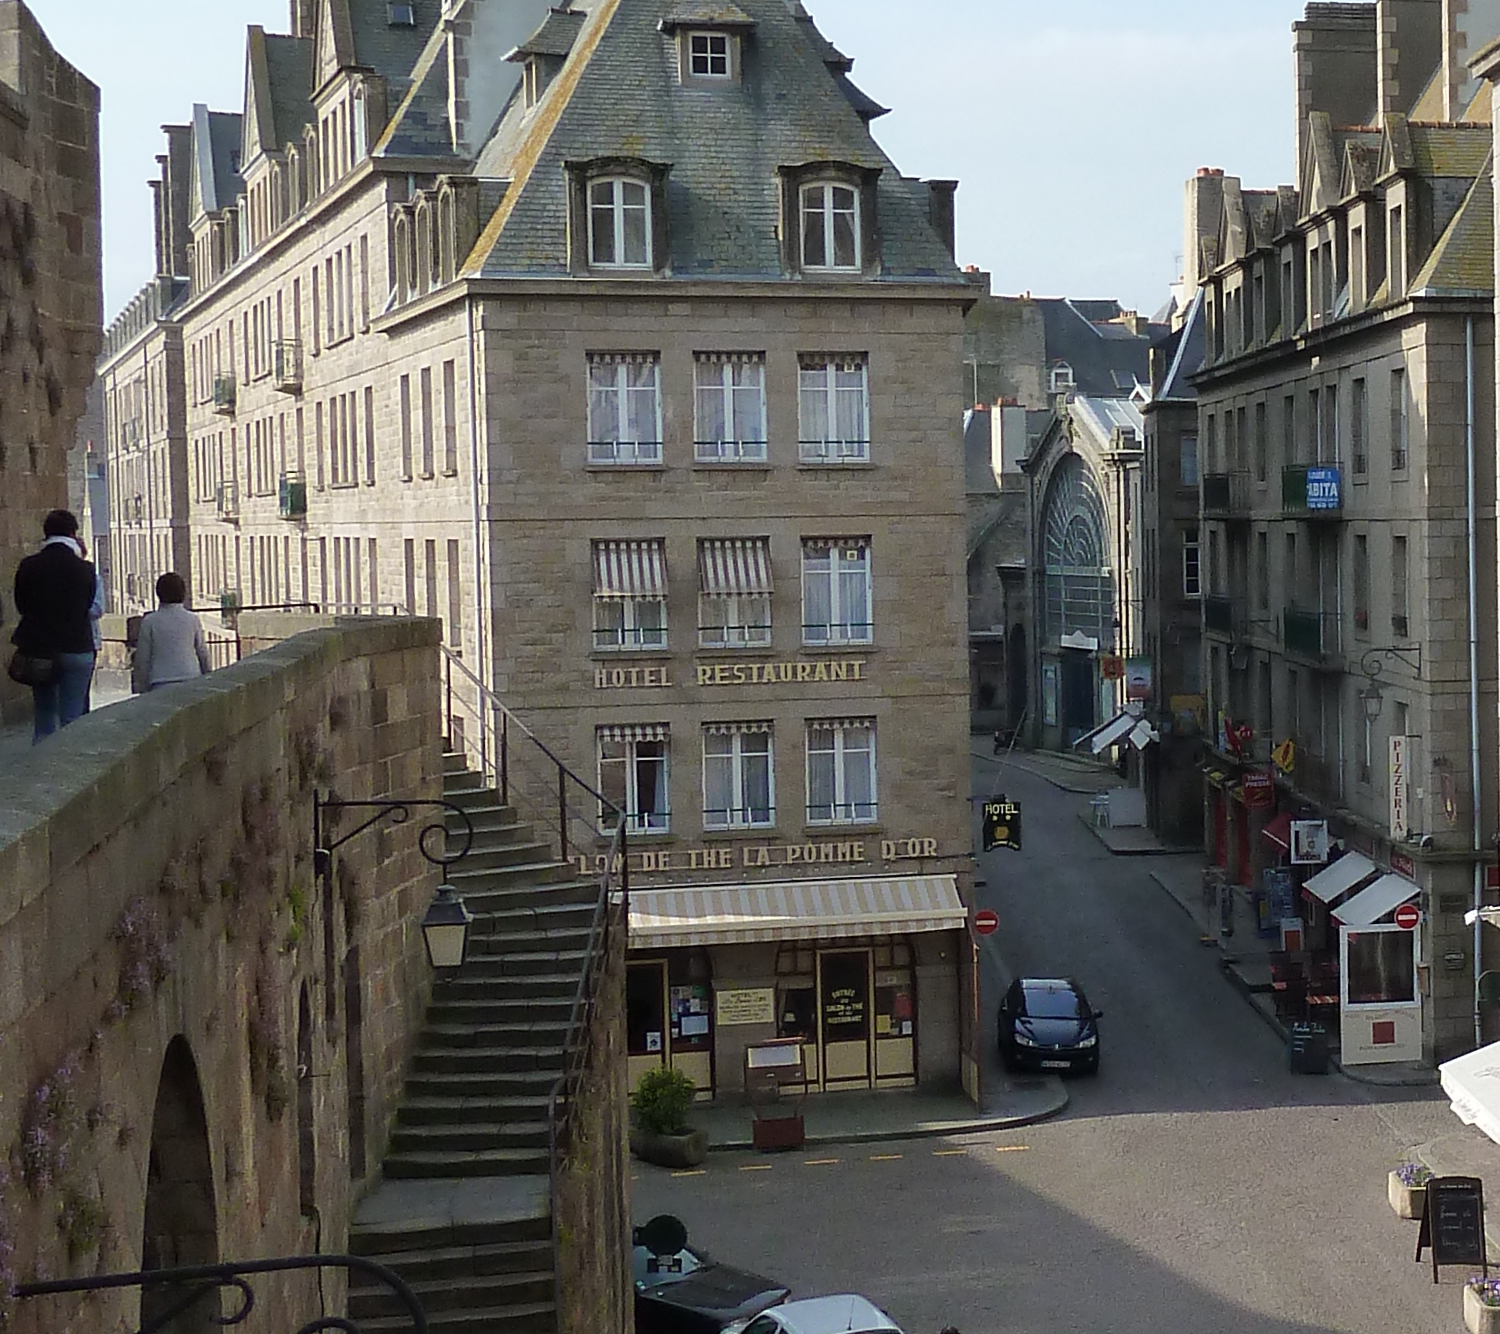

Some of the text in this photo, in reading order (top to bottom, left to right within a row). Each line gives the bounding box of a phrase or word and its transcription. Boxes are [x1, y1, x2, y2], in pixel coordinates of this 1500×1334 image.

[594, 661, 867, 688] HOTEL RESTAURANT
[1393, 739, 1404, 832] PIZZERIA
[985, 803, 1019, 815] HOTEL
[643, 851, 671, 872] DE
[688, 848, 733, 870] THE
[742, 844, 771, 866] LA
[786, 841, 866, 864] POMME
